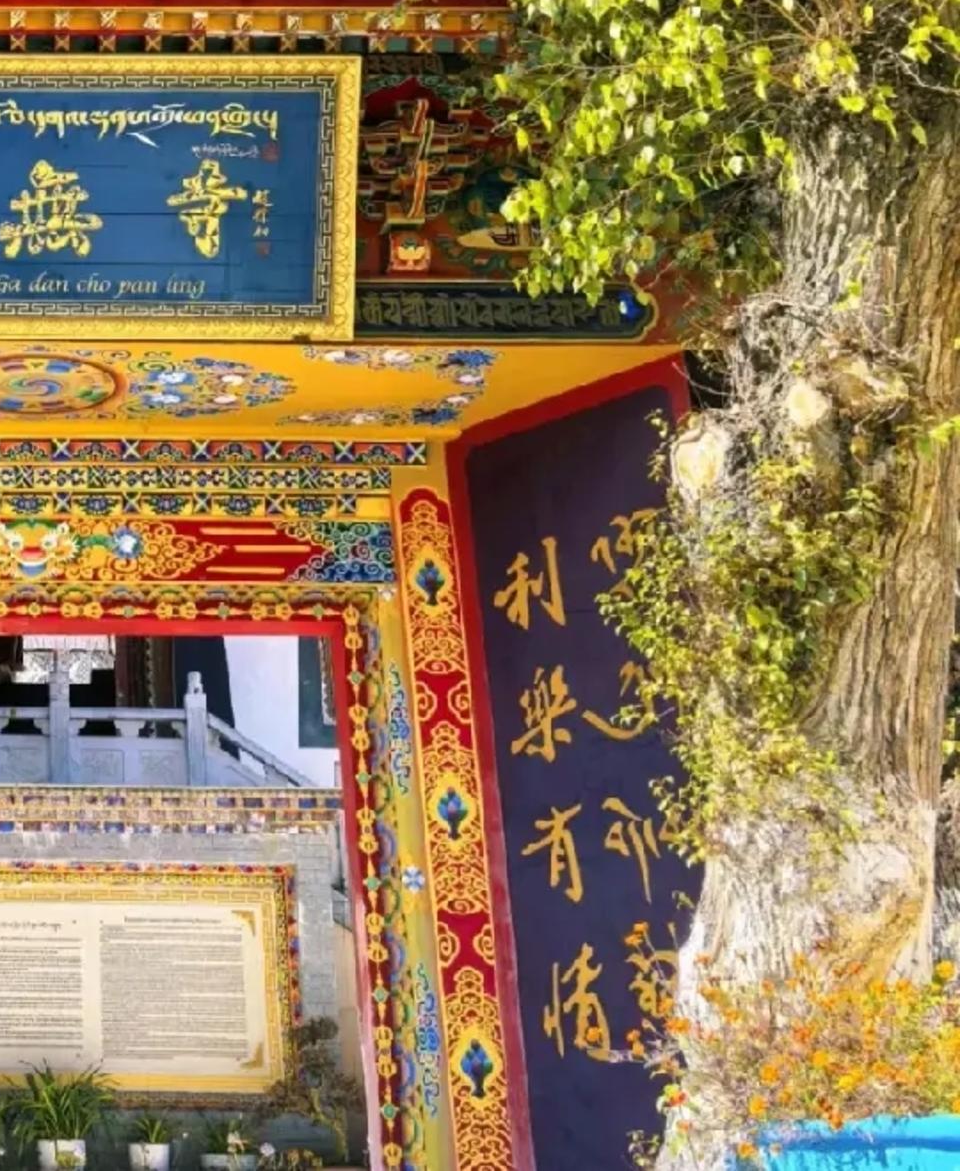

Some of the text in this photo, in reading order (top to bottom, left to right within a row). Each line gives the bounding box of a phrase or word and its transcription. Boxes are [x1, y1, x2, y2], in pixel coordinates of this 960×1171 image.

[28, 271, 70, 293] dan
[76, 272, 112, 292] cho
[113, 279, 159, 299] pan
